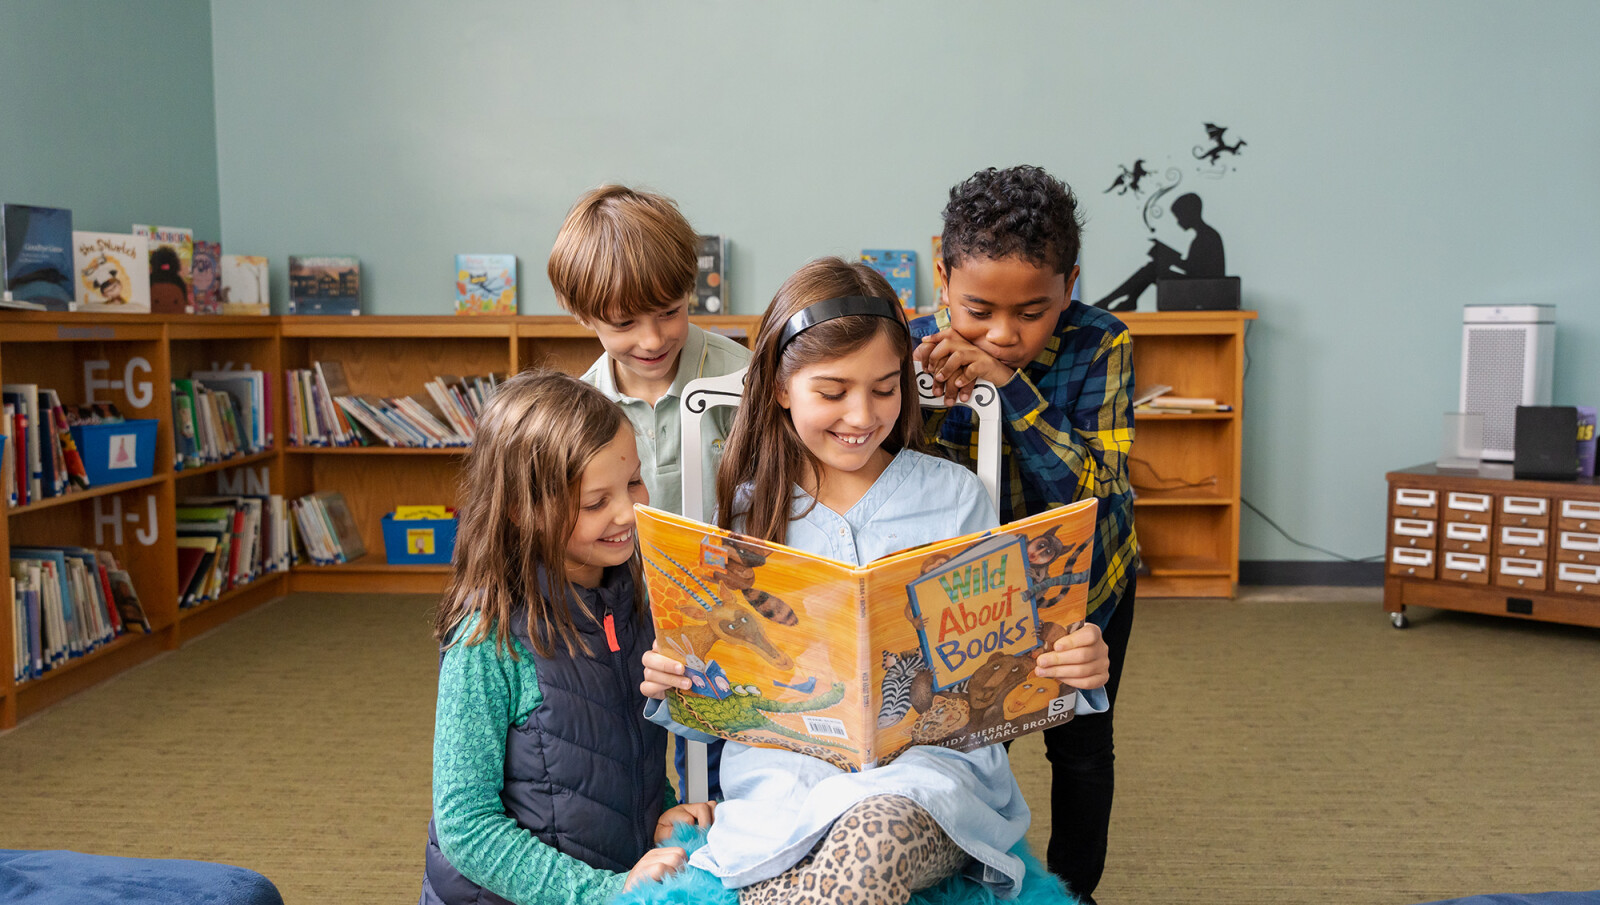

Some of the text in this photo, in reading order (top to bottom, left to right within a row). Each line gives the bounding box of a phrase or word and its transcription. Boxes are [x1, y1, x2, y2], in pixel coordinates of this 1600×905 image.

[84, 356, 153, 409] F-G
[94, 494, 158, 546] H-J
[938, 553, 1008, 604] Wild
[938, 584, 1021, 643] About
[935, 616, 1029, 673] Books
[983, 726, 1019, 743] MARC
[1022, 712, 1069, 731] BROWN
[1052, 698, 1065, 712] S
[937, 721, 1012, 748] UDY SIERRA
